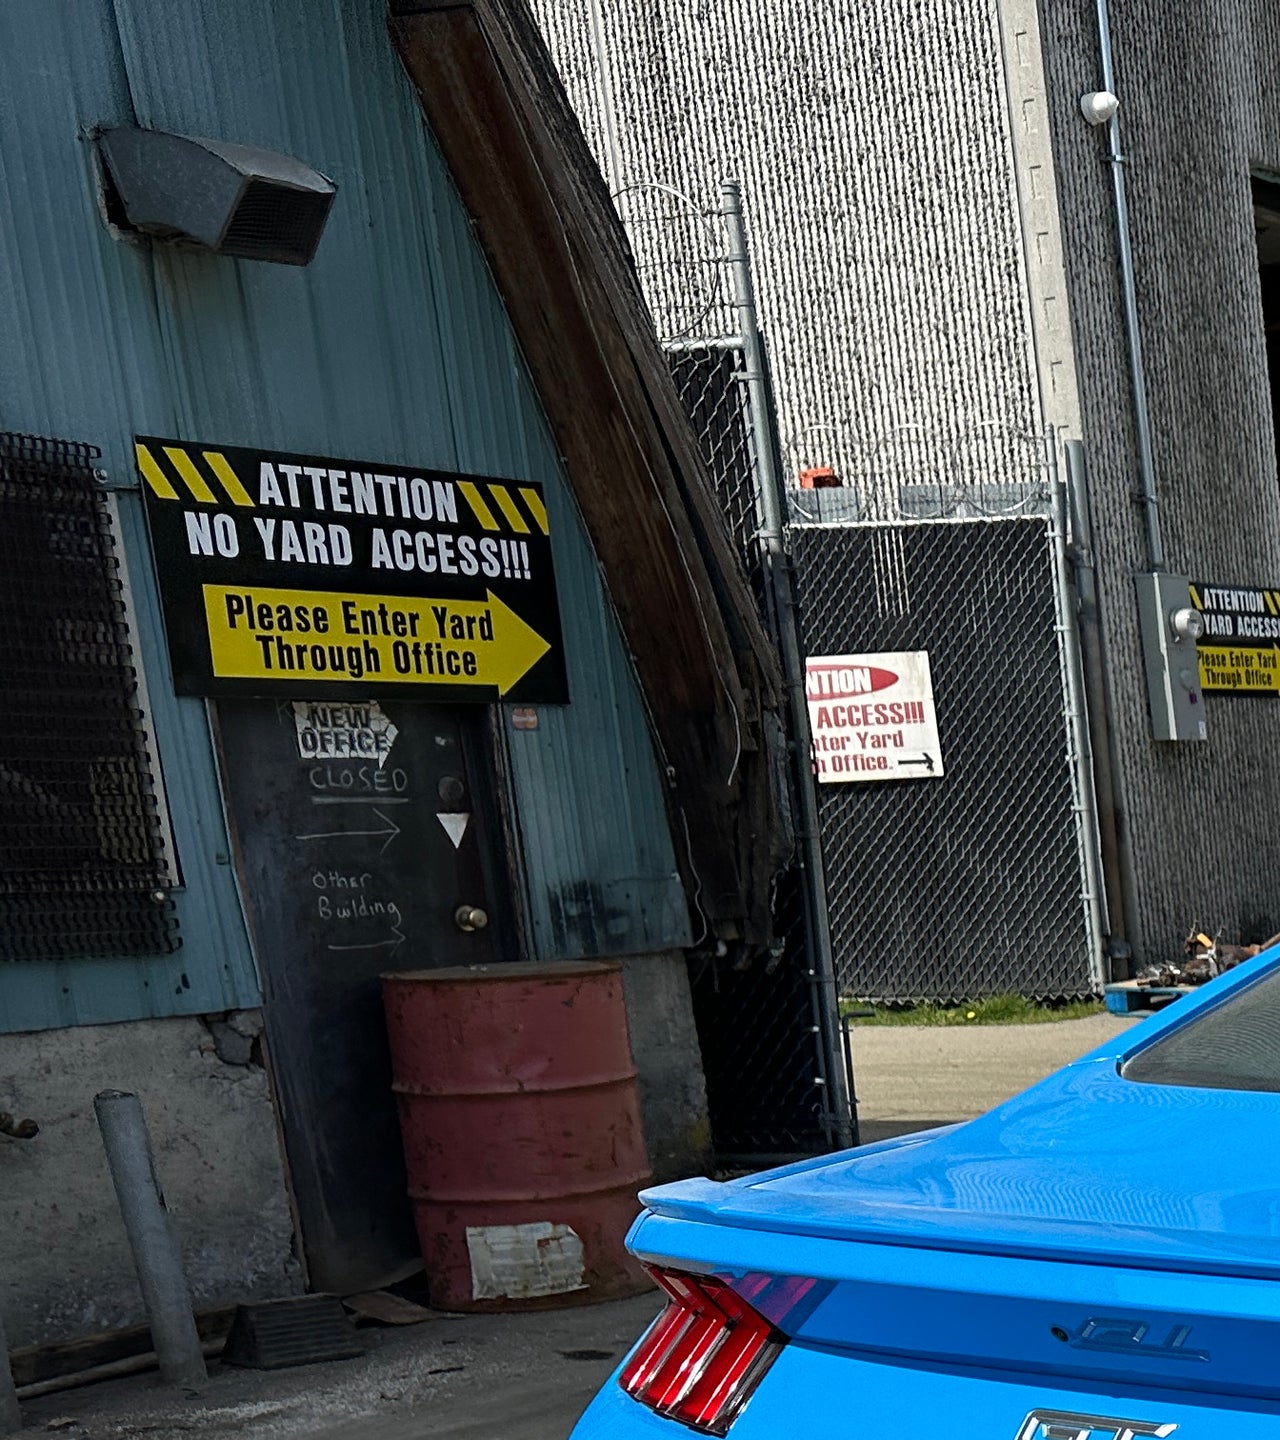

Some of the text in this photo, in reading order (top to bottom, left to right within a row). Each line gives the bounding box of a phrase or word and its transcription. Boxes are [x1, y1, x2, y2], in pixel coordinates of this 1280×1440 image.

[259, 461, 459, 523] ATTENTION
[184, 511, 531, 580] NO YARD ACCESS!!!
[1203, 588, 1265, 613] ATTENTION
[225, 593, 494, 641] Please Enter Yard
[1203, 613, 1233, 635] YARD
[255, 635, 477, 678] Through Office
[1229, 651, 1253, 668] Enter
[1257, 651, 1277, 669] Yard
[1205, 668, 1272, 688] Through Office
[310, 708, 370, 729] NEW
[817, 701, 926, 729] ACCESS!!!
[301, 730, 388, 751] OFFICE
[856, 730, 905, 750] Yard
[309, 767, 408, 792] CLOSED
[318, 896, 401, 927] Building
